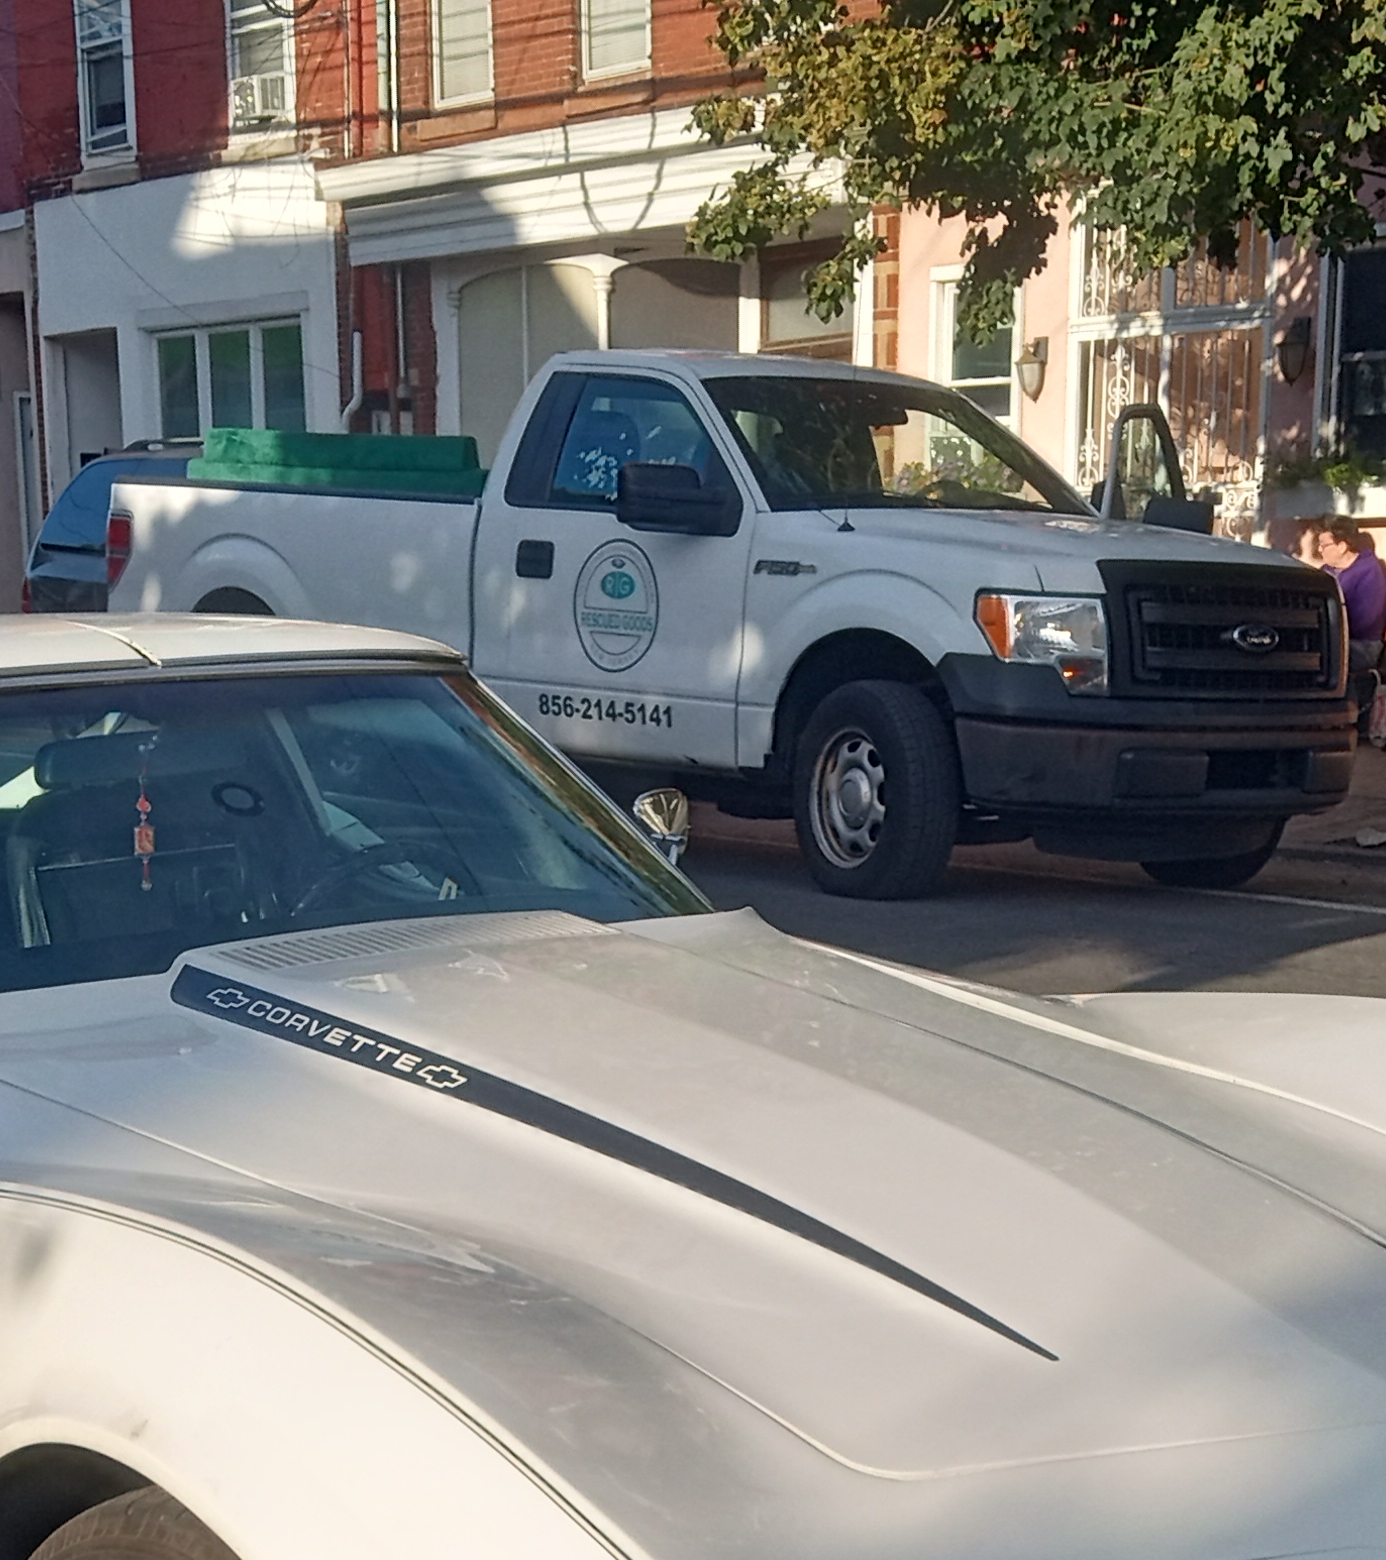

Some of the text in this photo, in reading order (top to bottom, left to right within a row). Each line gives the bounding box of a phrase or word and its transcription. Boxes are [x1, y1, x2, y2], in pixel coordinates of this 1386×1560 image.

[581, 611, 653, 632] RESCUED GOODS
[539, 693, 673, 728] 856-214-5141
[247, 1000, 422, 1073] CORVETTE
